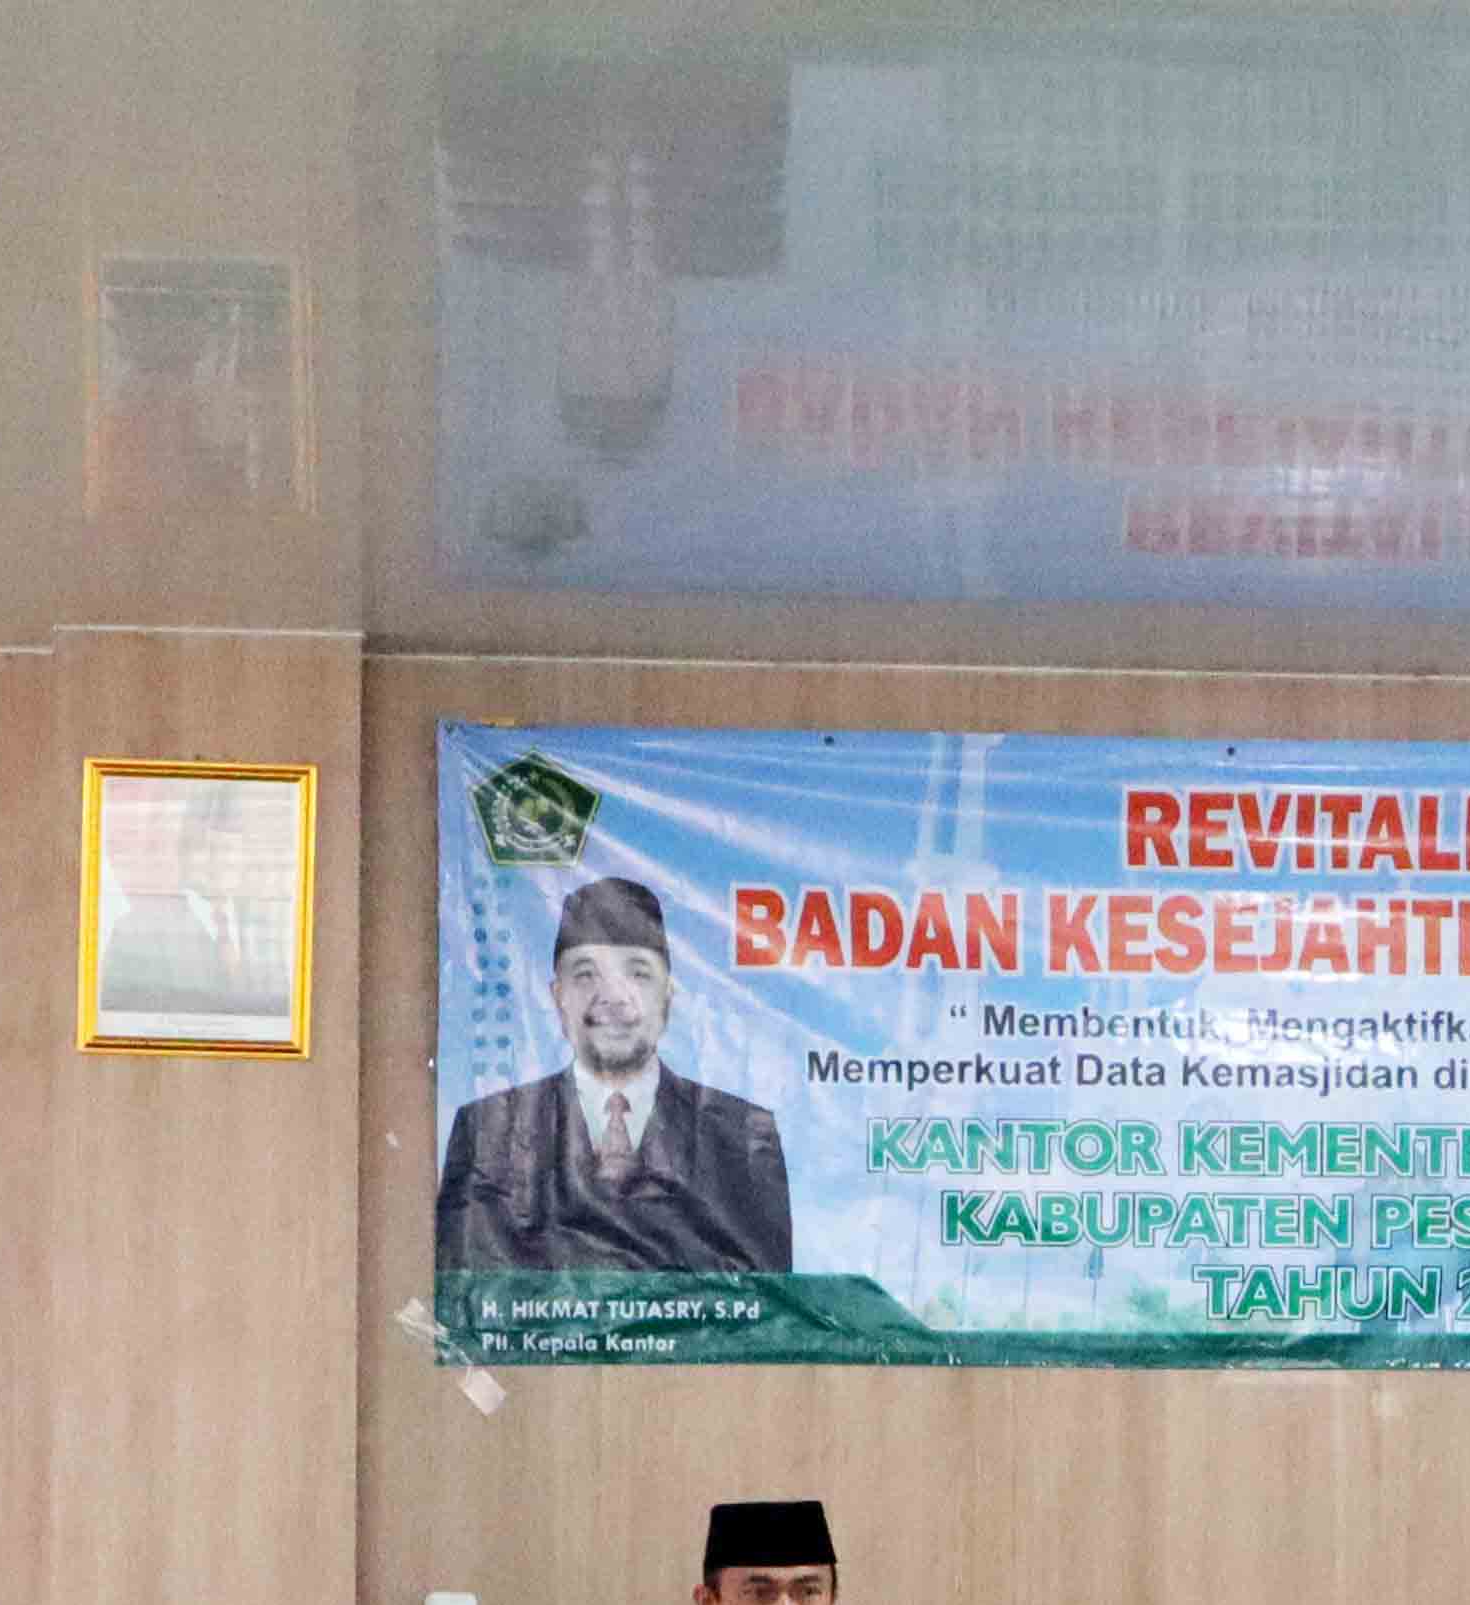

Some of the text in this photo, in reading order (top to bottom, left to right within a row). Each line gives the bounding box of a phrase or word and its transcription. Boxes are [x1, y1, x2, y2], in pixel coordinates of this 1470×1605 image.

[735, 888, 1019, 971] BADAN
[983, 1004, 1232, 1045] Membentuk,
[807, 1050, 1062, 1091] Memperkuat
[1077, 1054, 1166, 1087] Data
[1182, 1056, 1419, 1097] Kemasjidan
[1433, 1059, 1469, 1089] di
[866, 1117, 1168, 1176] KANTOR
[941, 1190, 1354, 1249] KABUPATEN
[481, 1300, 761, 1321] H. HIKMAT TUTASRY, S.Pd
[1192, 1264, 1442, 1321] TAHUN
[523, 1333, 598, 1356] Kepala
[606, 1334, 676, 1352] Kantor
